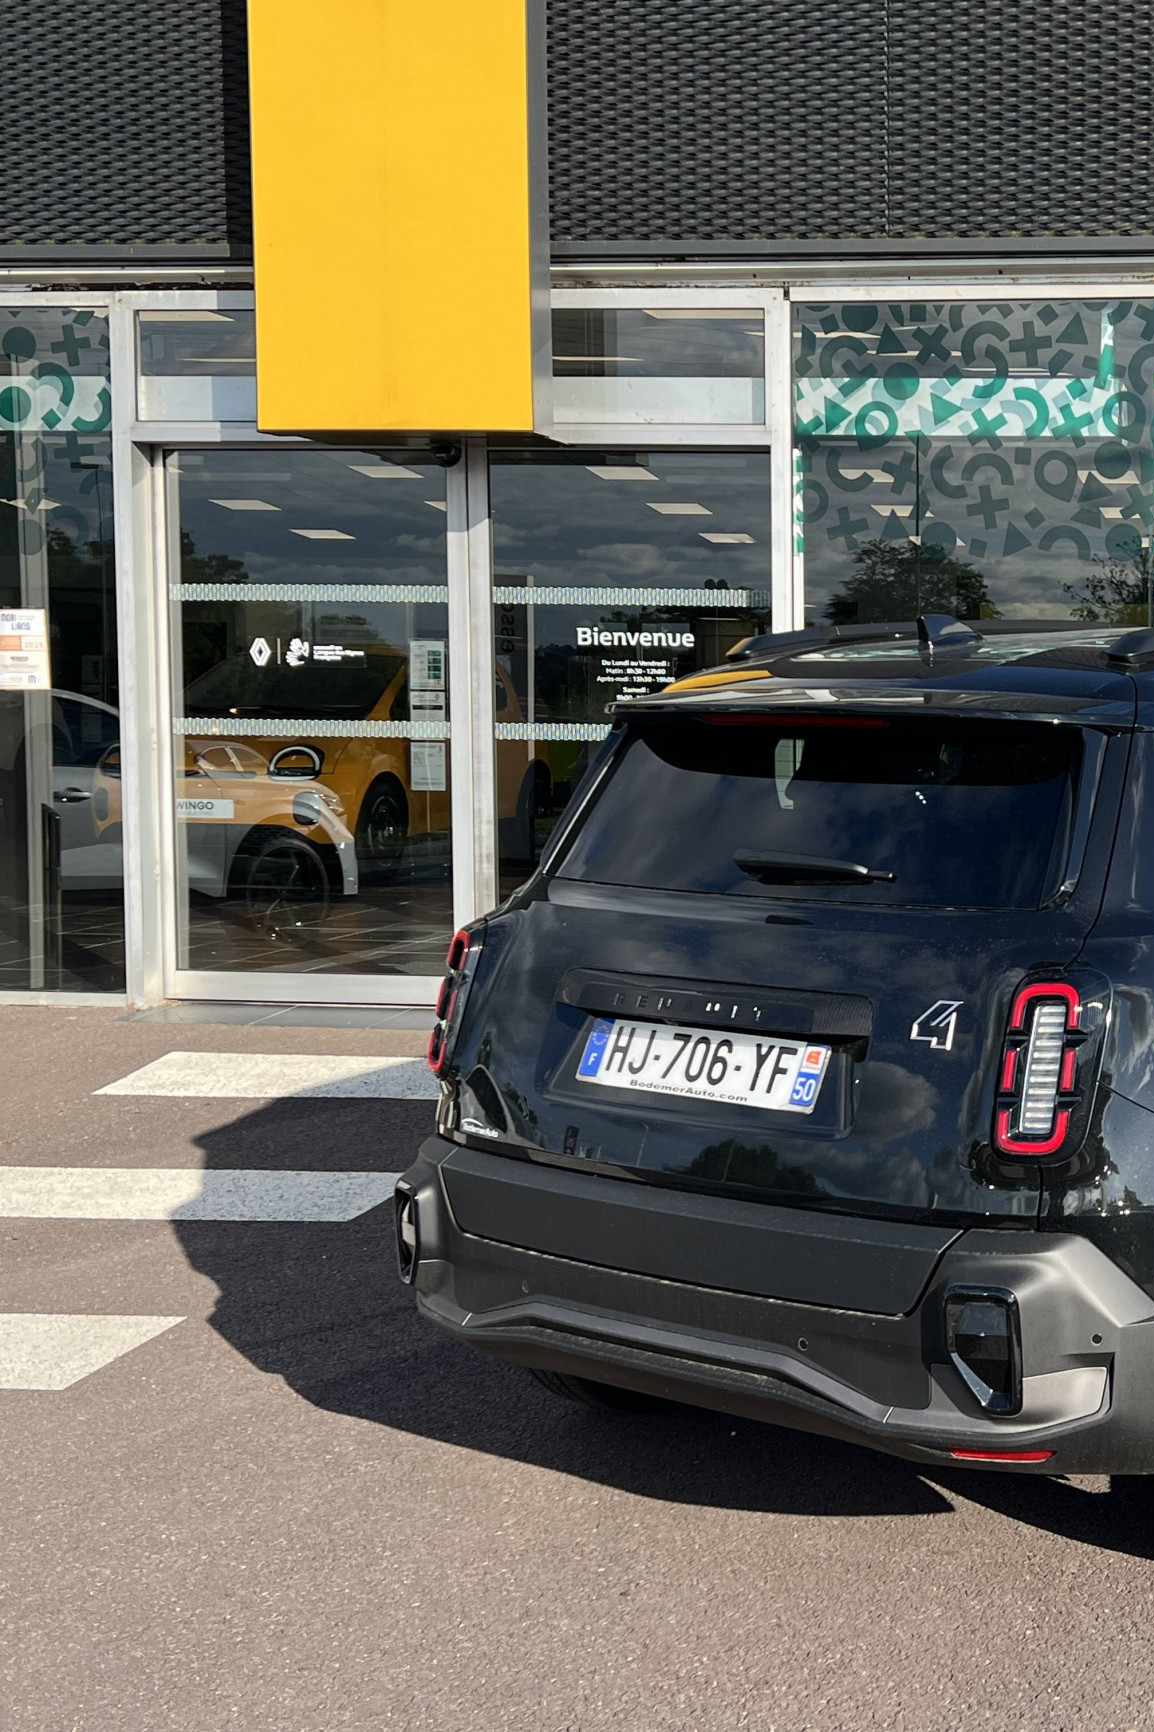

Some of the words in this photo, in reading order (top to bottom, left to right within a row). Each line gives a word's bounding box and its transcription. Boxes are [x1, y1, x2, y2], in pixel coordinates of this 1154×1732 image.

[576, 626, 695, 647] Bienvenue
[587, 1052, 599, 1067] F
[605, 1025, 798, 1093] HJ-706-YF
[792, 1076, 815, 1102] 50
[629, 1079, 748, 1102] BodemerAuto.com
